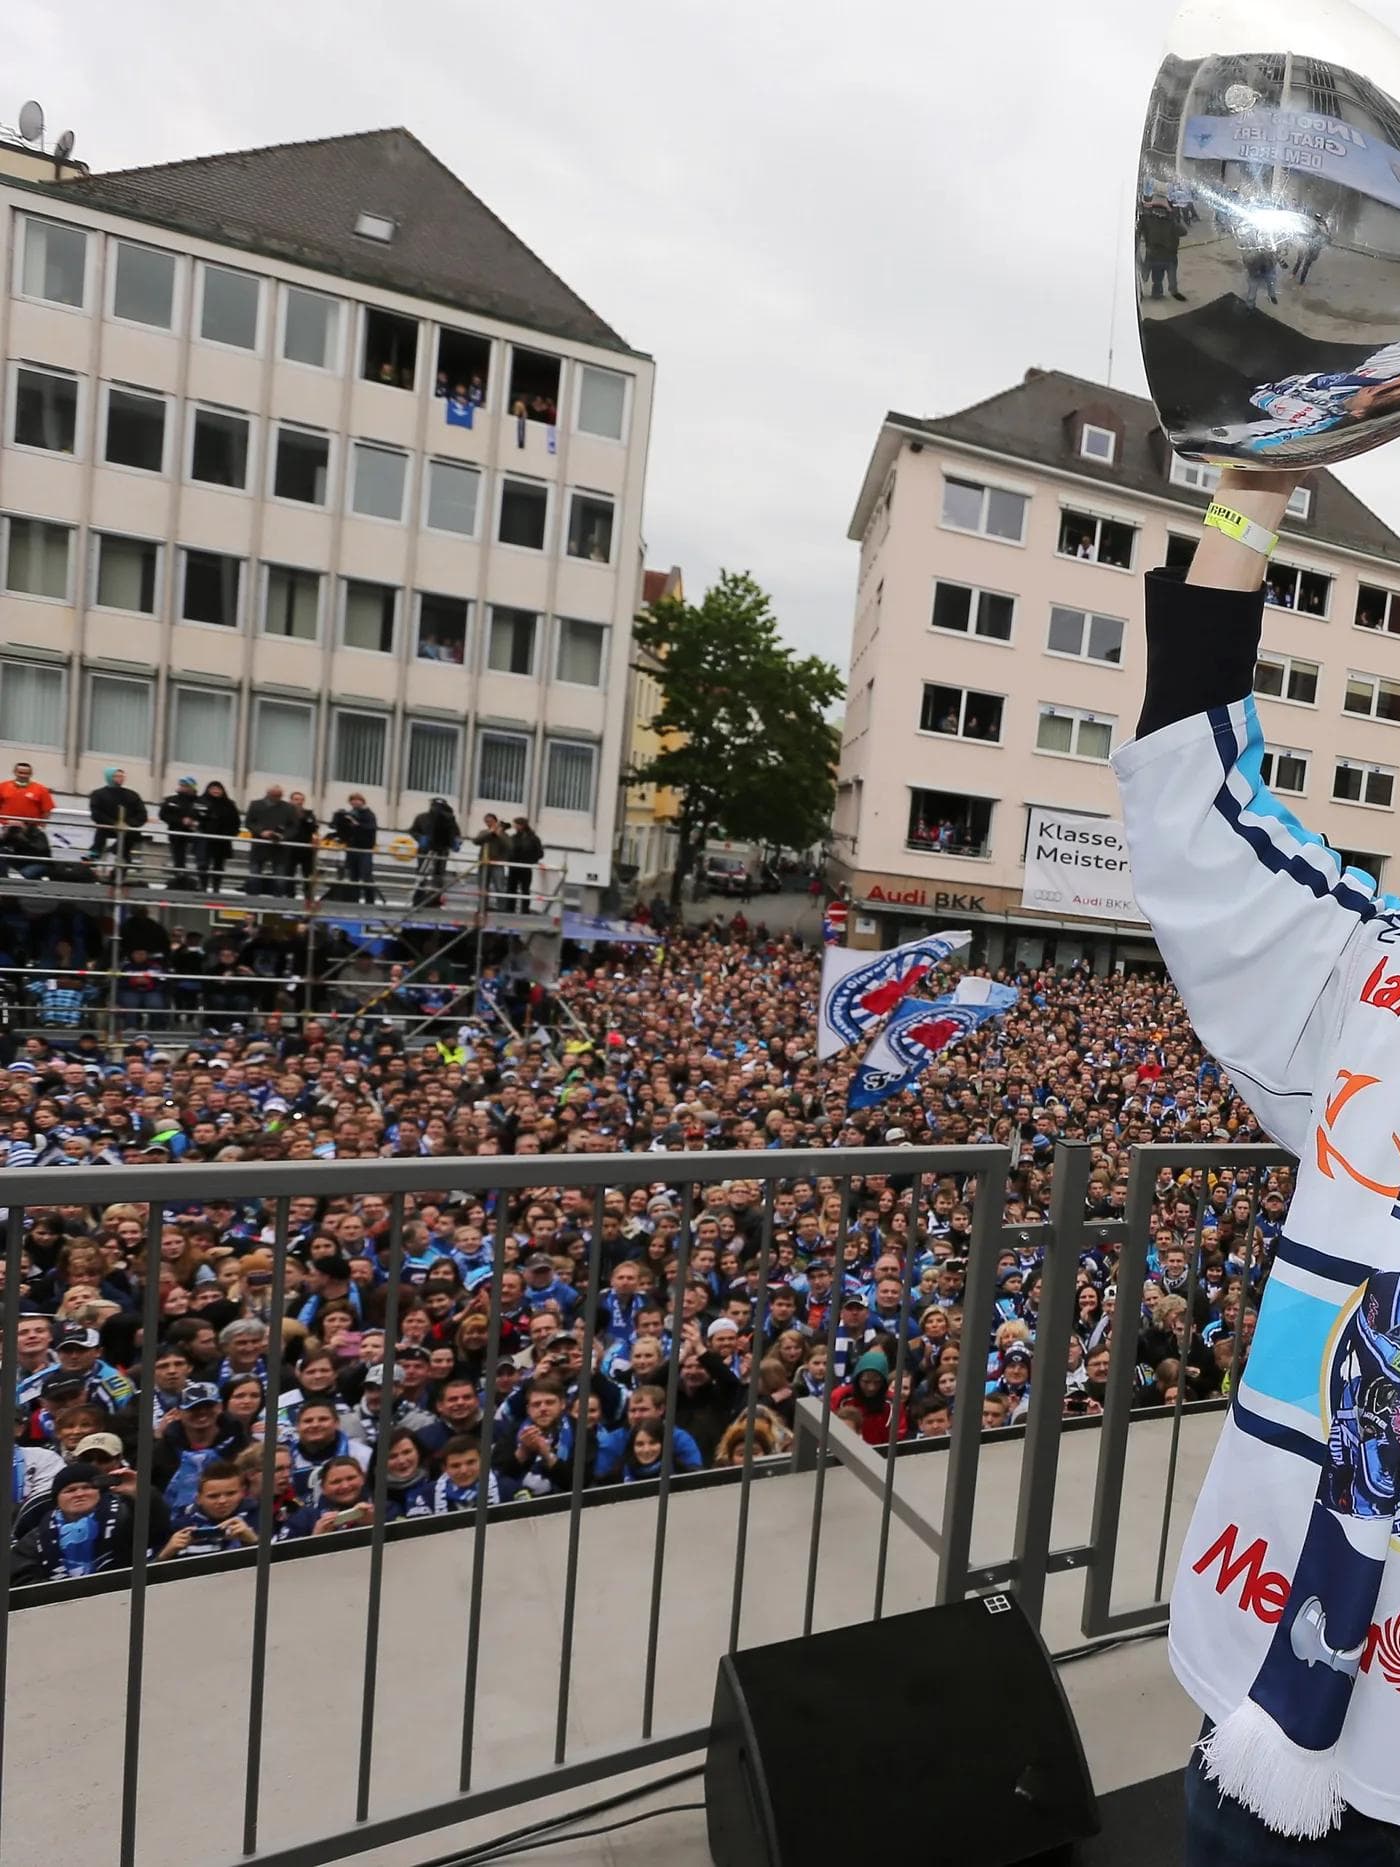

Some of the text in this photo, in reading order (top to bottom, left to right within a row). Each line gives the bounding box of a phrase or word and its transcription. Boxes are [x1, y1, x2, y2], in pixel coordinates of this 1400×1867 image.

[1039, 822, 1124, 851] Klasse,
[1036, 845, 1132, 873] Meister.
[867, 886, 985, 912] Audi BKK
[1072, 895, 1132, 910] Audi BKK
